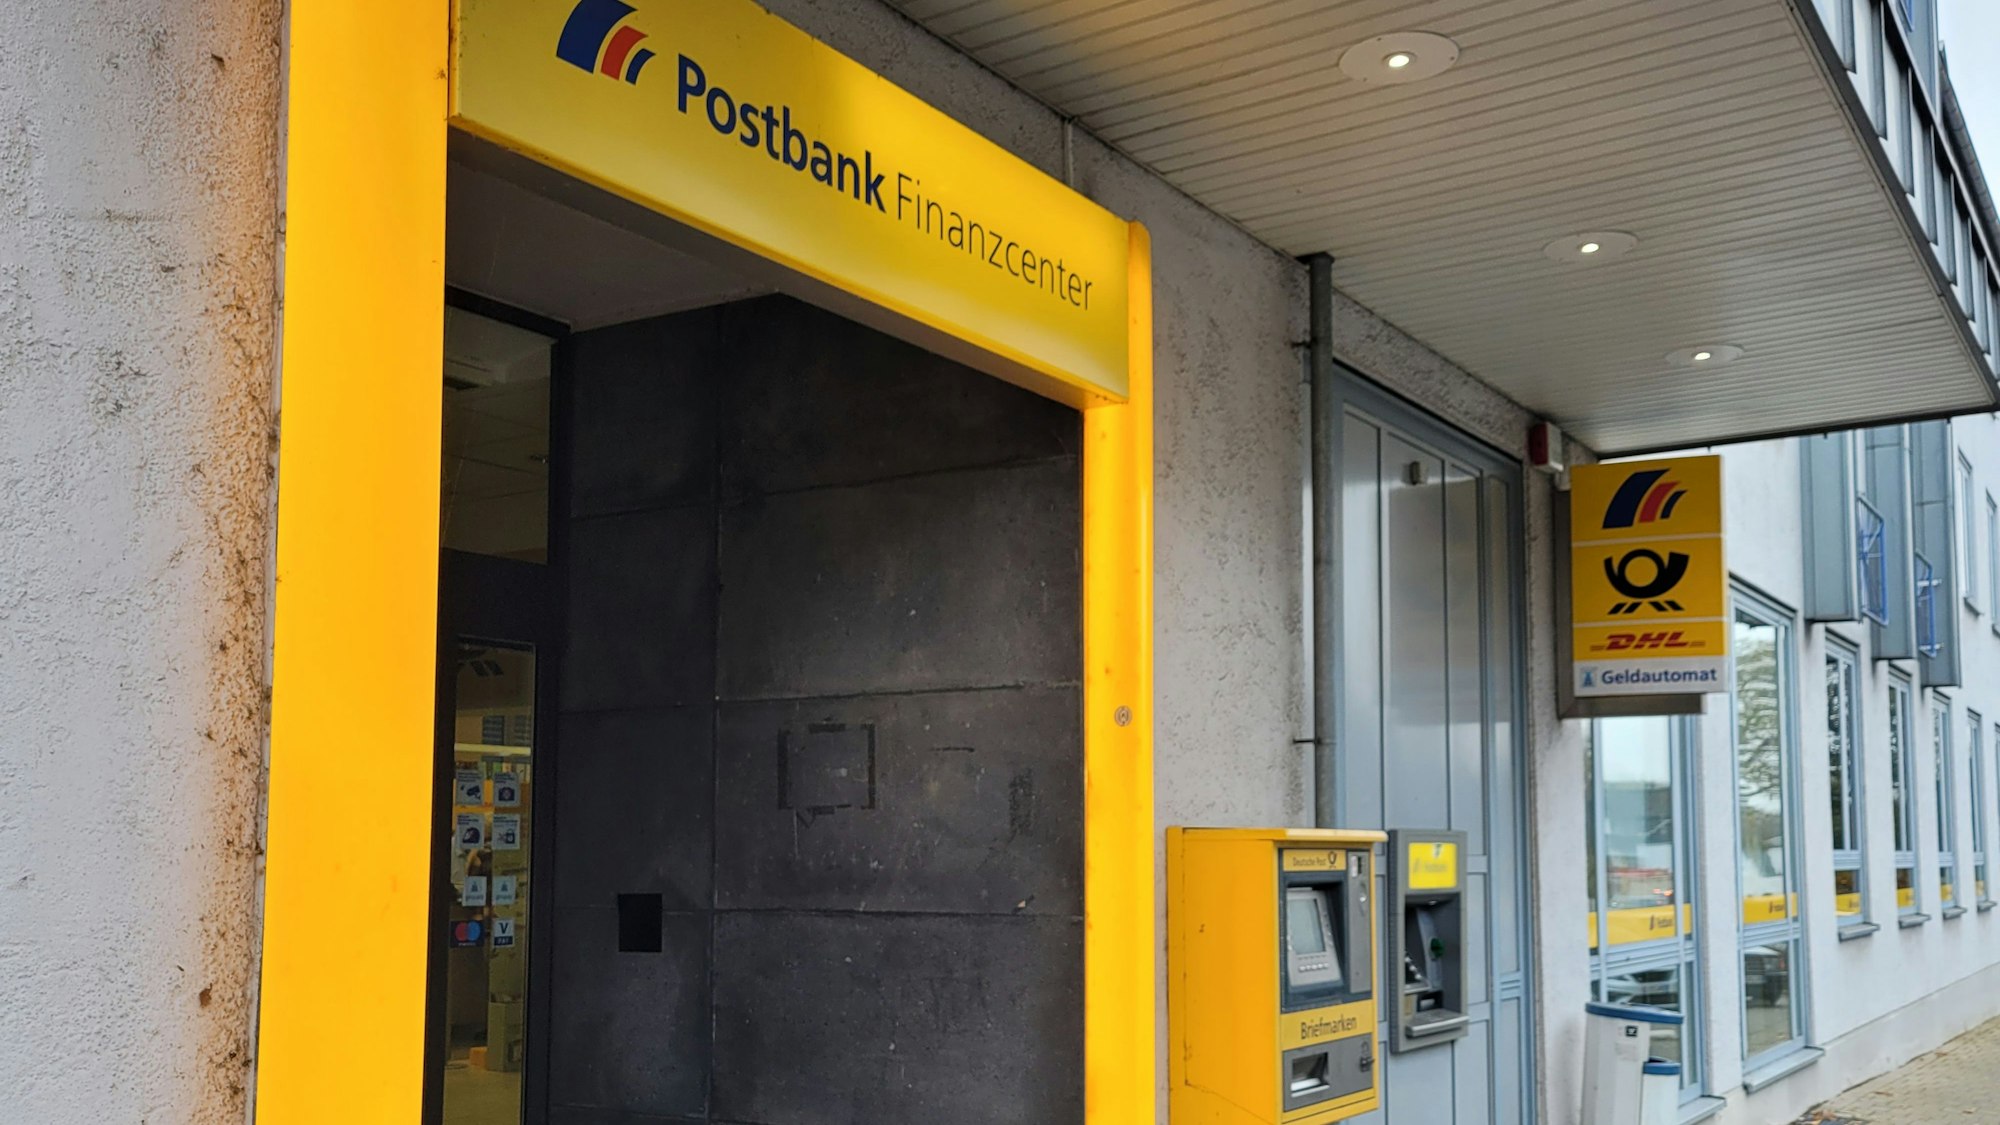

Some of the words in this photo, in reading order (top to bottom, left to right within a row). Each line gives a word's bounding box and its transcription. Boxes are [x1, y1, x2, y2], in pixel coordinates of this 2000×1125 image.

[676, 53, 886, 214] Postbank
[896, 172, 1094, 311] Finanzcenter
[1607, 632, 1688, 650] DHL
[1602, 668, 1717, 684] Geldautomat
[499, 922, 509, 934] V
[1301, 1014, 1356, 1038] Briefmarken
